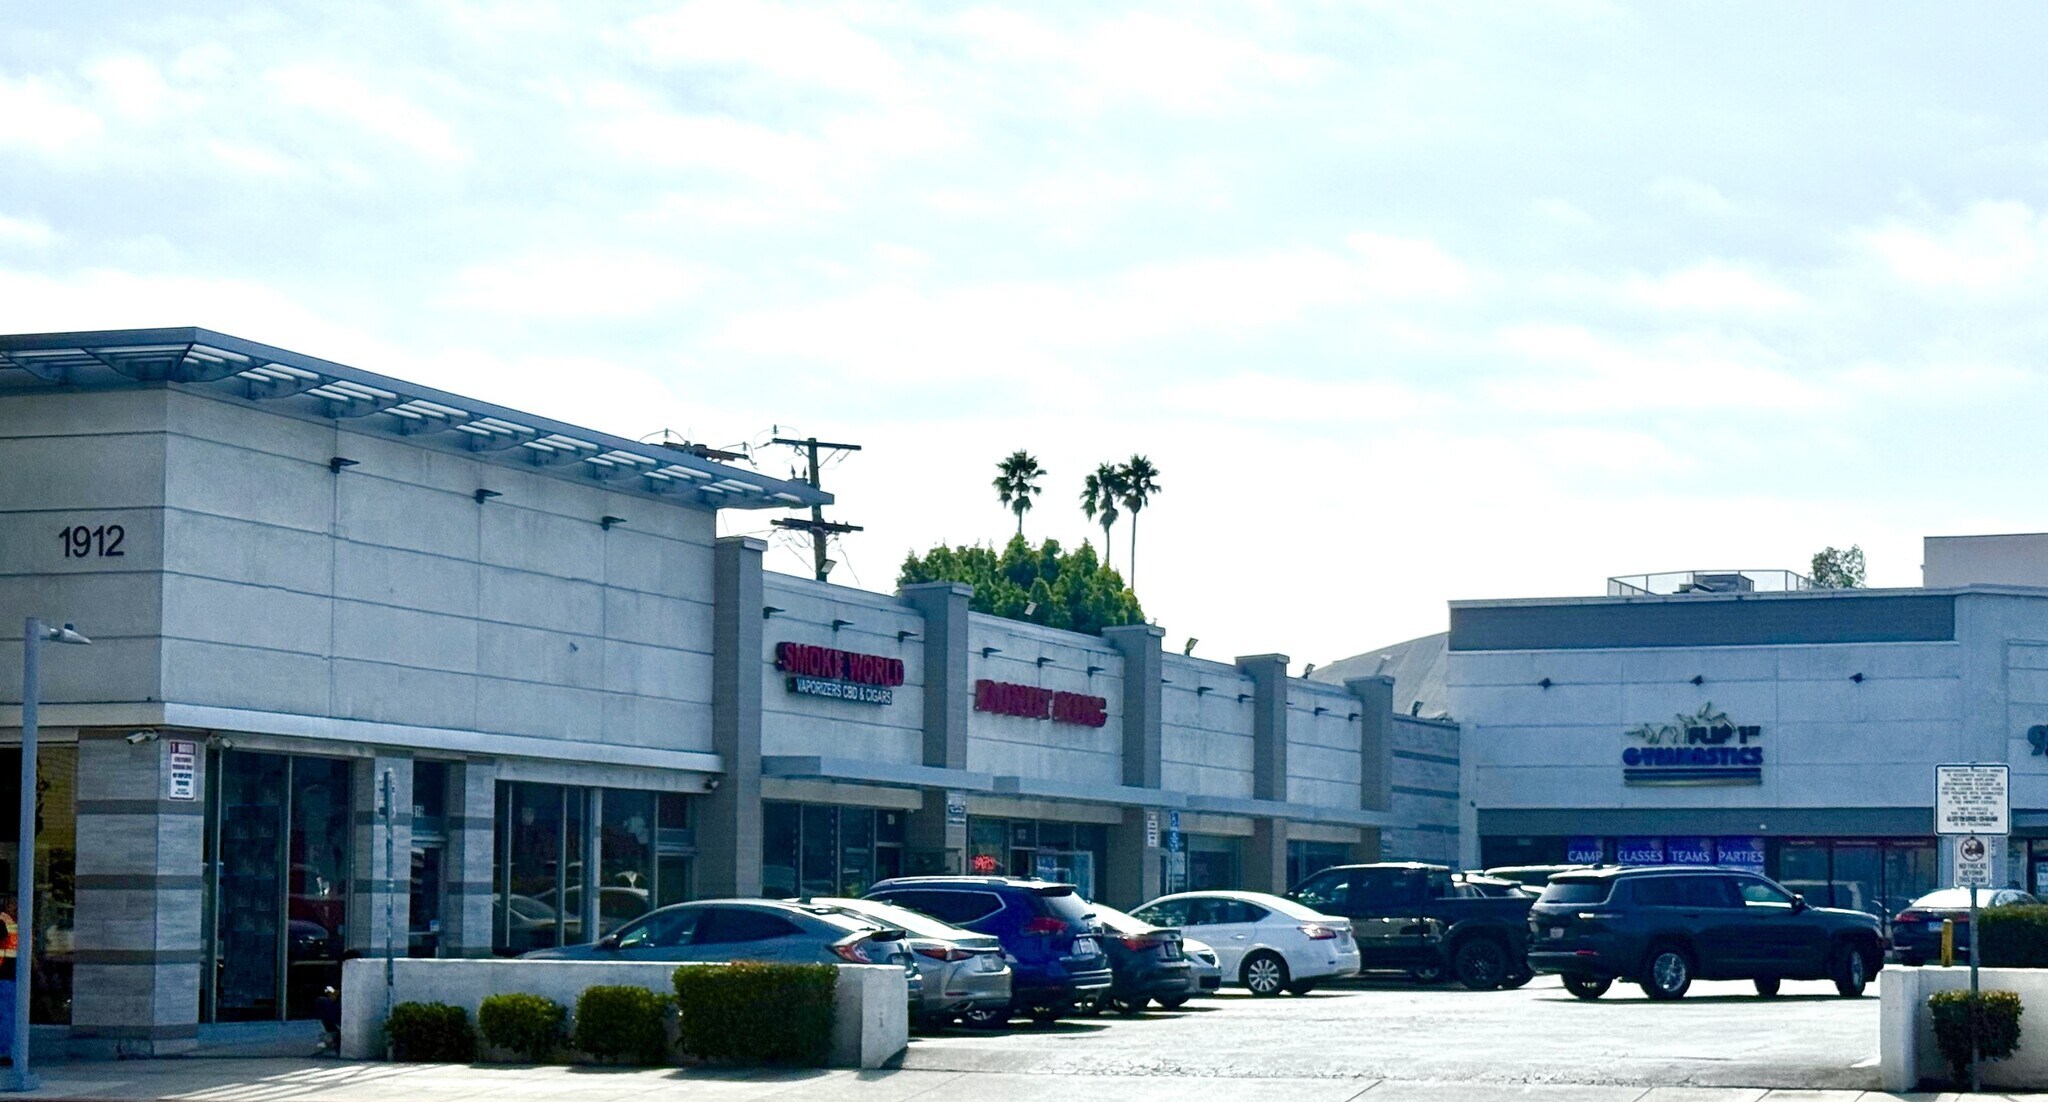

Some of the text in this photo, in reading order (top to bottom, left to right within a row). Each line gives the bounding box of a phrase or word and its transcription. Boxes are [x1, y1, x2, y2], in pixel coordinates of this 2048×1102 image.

[58, 525, 125, 558] 1912
[777, 641, 904, 688] SMOKE WORLD
[796, 678, 892, 705] VAPORIZERS CBD & CIGARS
[1622, 747, 1764, 766] GYMNASTICS
[1567, 850, 1603, 862] CAMP
[1617, 850, 1664, 863] CLASSES
[1672, 851, 1710, 863] TEAMS
[1717, 850, 1765, 863] PARTIES
